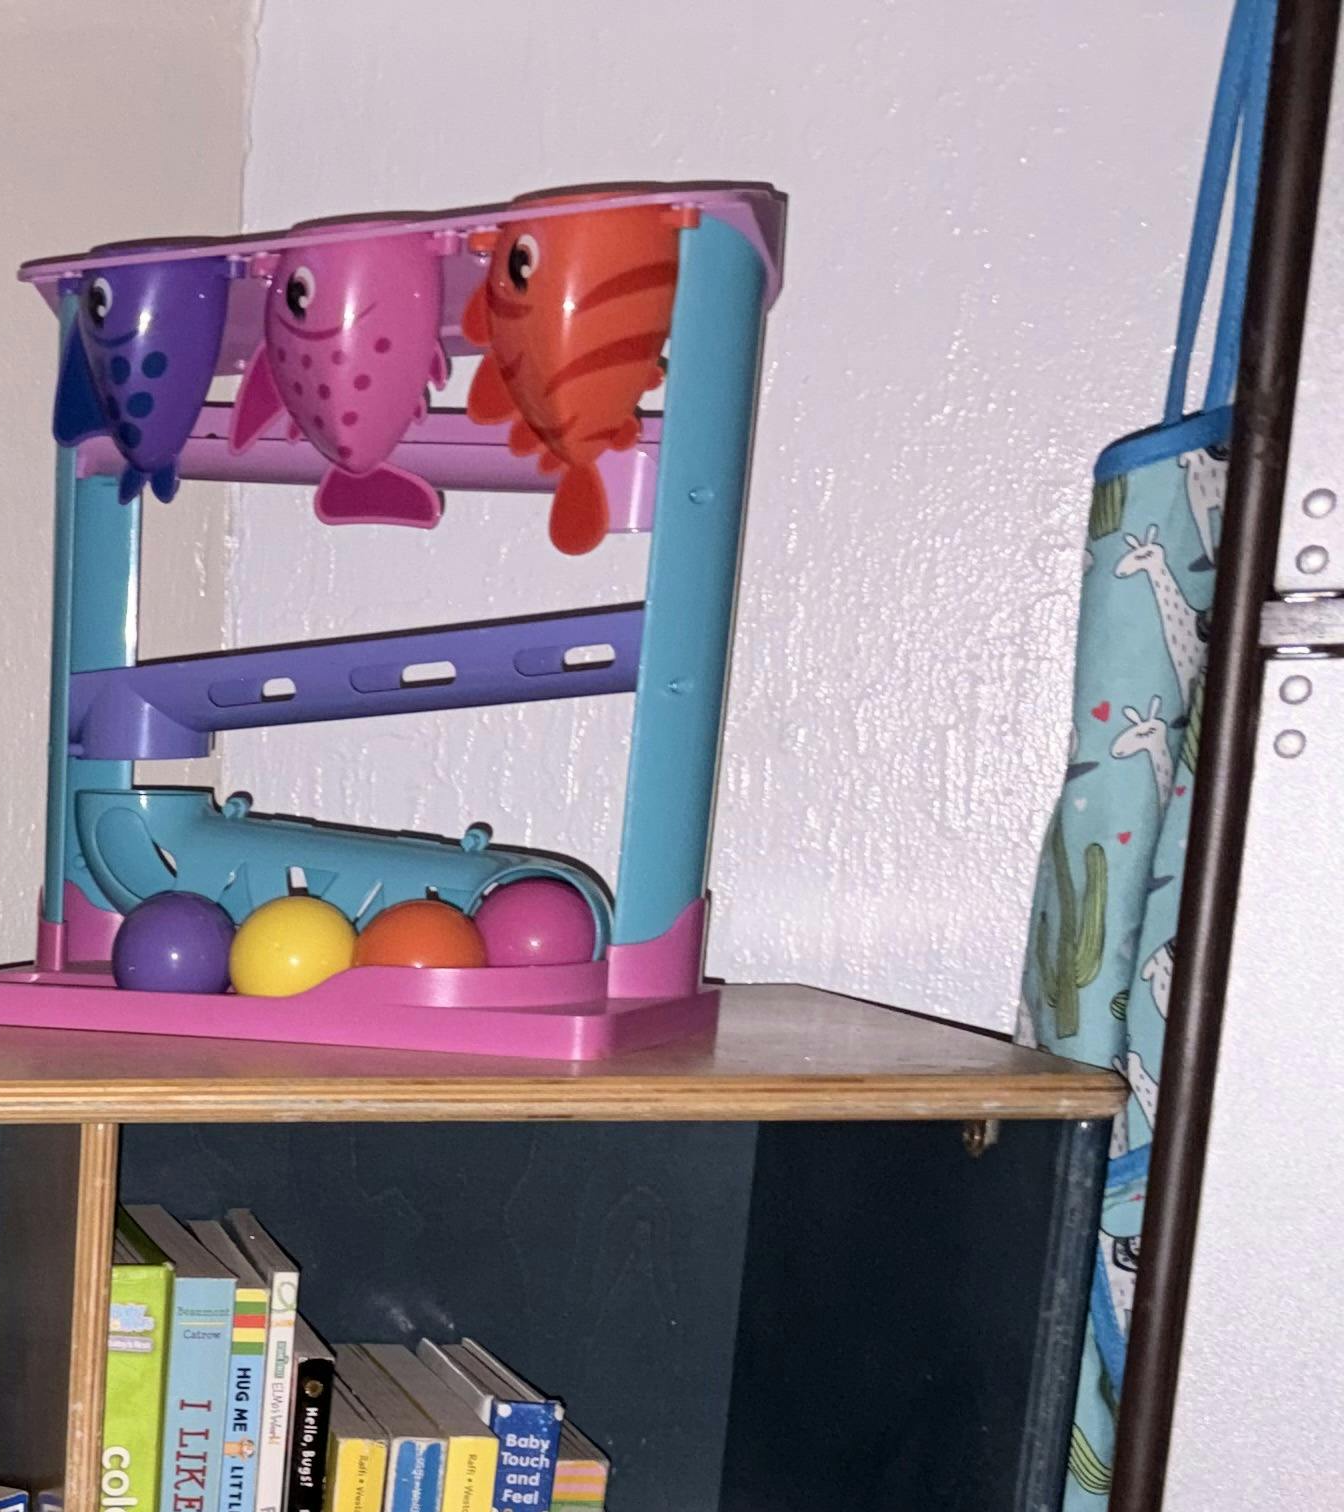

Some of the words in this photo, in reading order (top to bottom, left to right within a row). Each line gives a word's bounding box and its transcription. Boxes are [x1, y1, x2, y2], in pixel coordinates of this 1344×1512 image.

[183, 1329, 221, 1340] Catrow
[236, 1367, 252, 1402] HUG
[179, 1399, 212, 1413] I
[232, 1408, 248, 1433] ME
[300, 1407, 319, 1446] Hello,
[506, 1433, 551, 1452] Baby
[298, 1450, 316, 1488] Bugs!
[467, 1454, 478, 1476] Raffi
[501, 1452, 551, 1469] Touch
[506, 1473, 540, 1486] and
[501, 1489, 540, 1505] Feel
